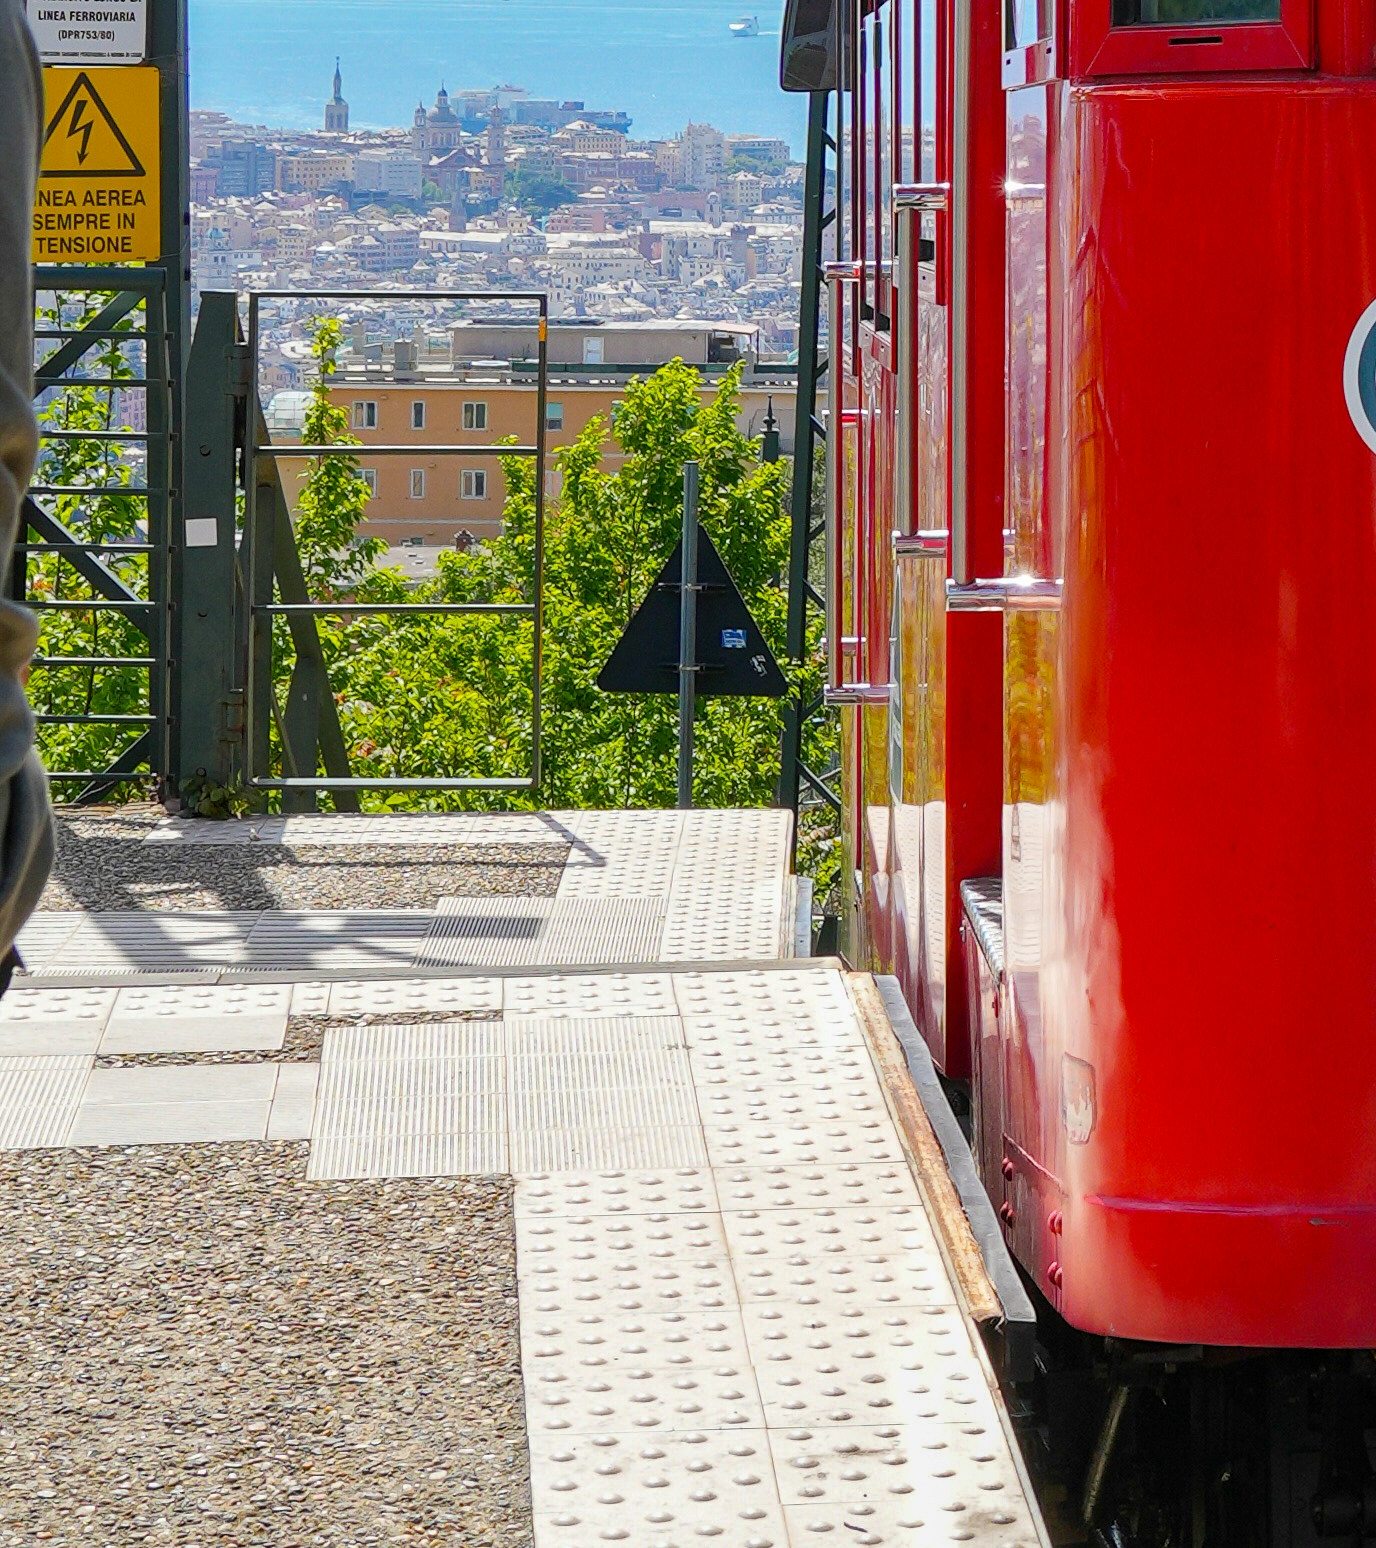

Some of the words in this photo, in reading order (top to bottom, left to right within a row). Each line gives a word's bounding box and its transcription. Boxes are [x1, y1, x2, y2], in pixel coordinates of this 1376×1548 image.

[38, 10, 66, 21] LINEA
[69, 10, 136, 22] FERROVIARIA
[34, 189, 77, 207] NEA
[82, 189, 146, 207] AEREA
[32, 213, 111, 231] SEMPRE
[118, 213, 135, 229] IN
[35, 236, 133, 254] TENSIONE
